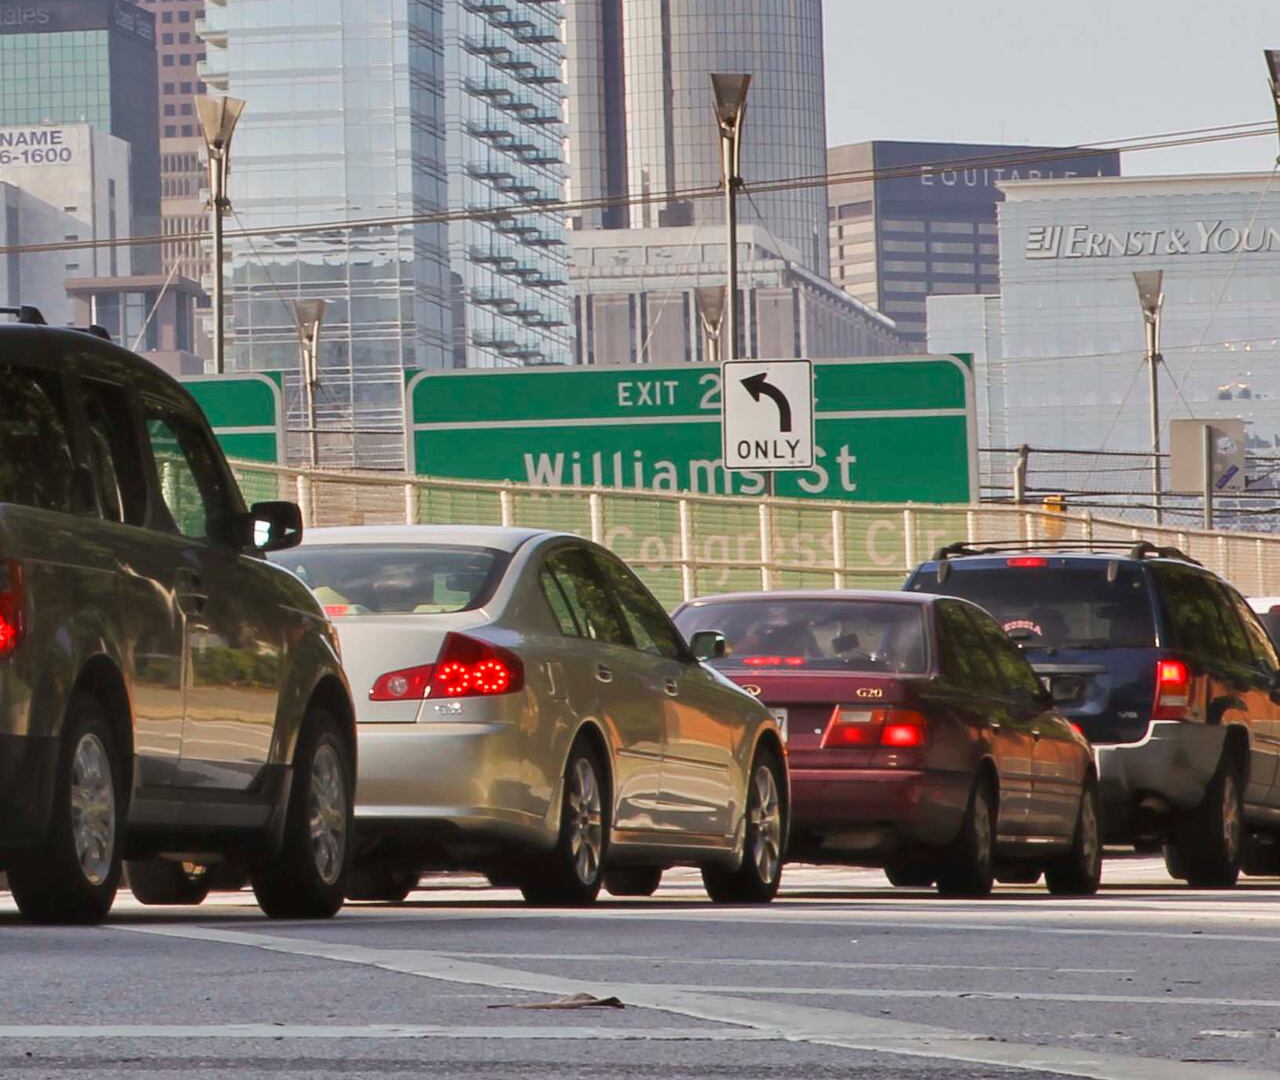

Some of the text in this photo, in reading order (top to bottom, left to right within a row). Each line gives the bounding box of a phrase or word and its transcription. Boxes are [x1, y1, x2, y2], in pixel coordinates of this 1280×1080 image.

[0, 130, 64, 147] NAME
[1065, 224, 1165, 259] ERNST
[1166, 228, 1190, 256] &
[617, 380, 680, 407] EXIT
[737, 438, 801, 459] ONLY
[523, 444, 857, 500] Williams St
[856, 687, 883, 698] G20
